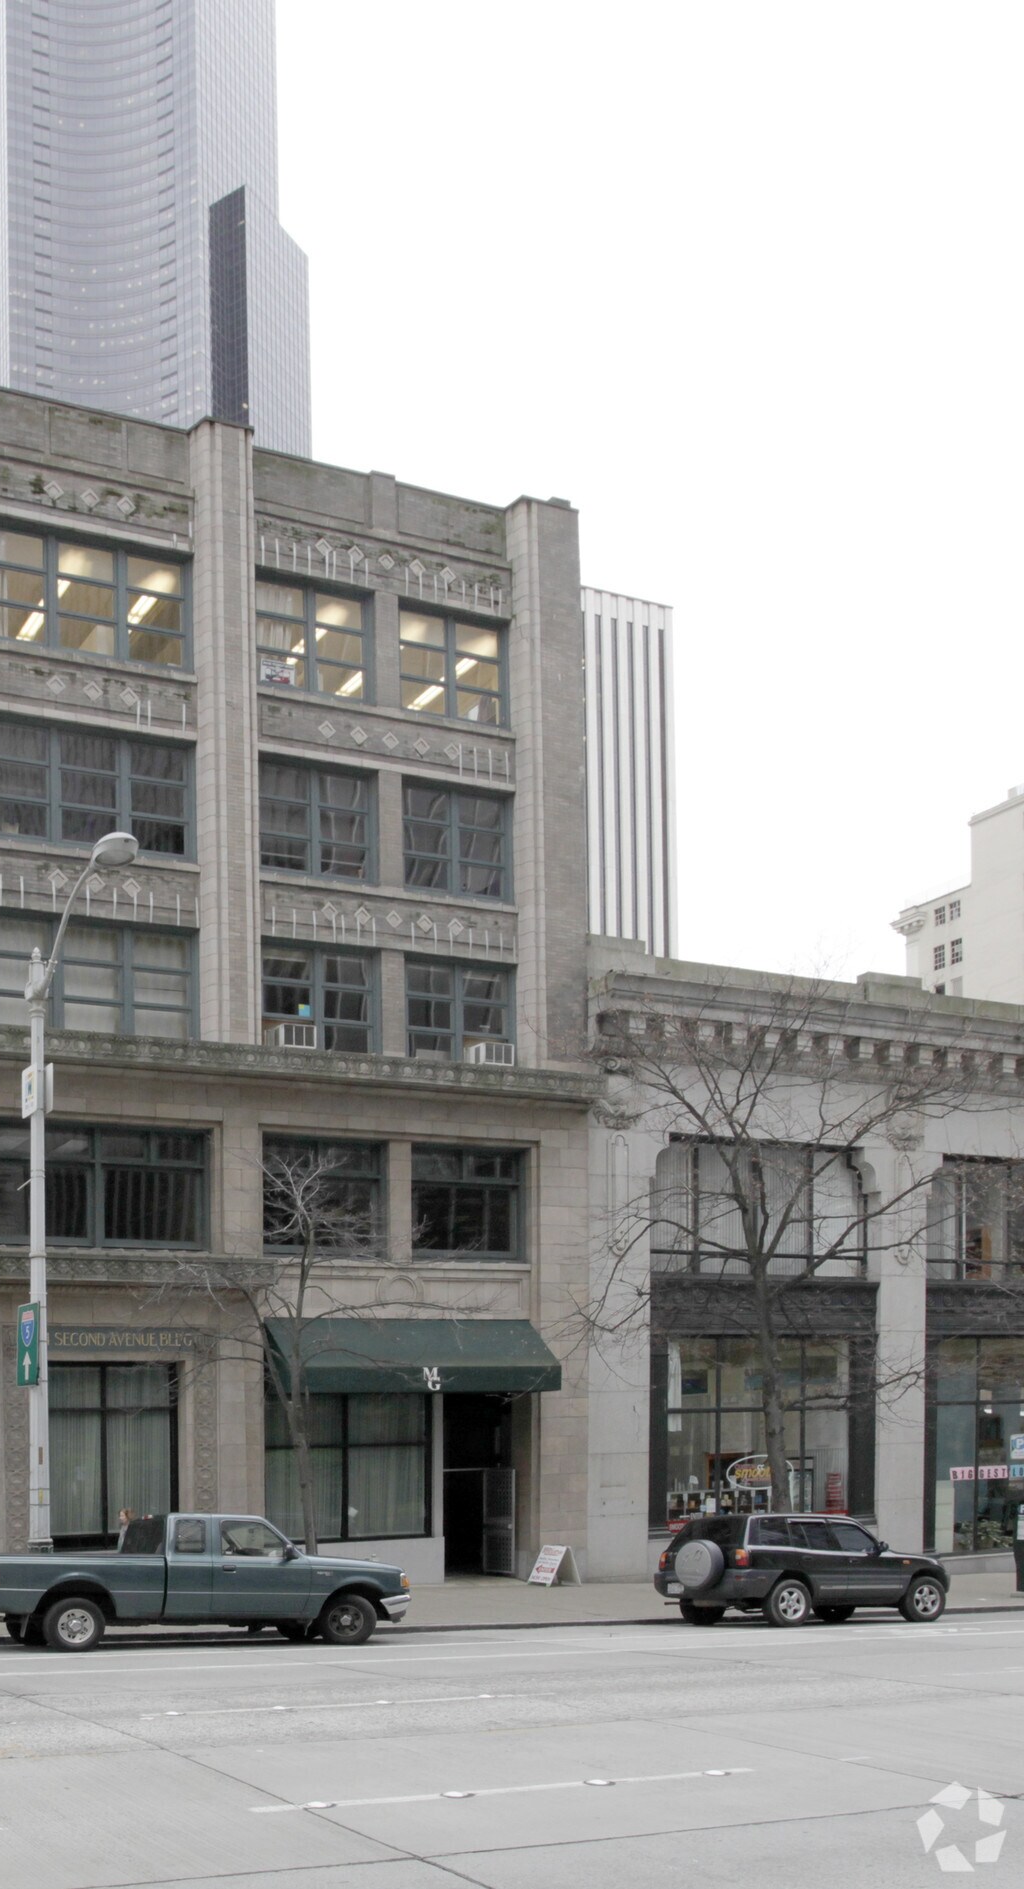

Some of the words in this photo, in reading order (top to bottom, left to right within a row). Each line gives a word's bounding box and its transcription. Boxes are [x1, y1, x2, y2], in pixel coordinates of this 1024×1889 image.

[25, 1325, 30, 1340] 5
[54, 1332, 106, 1346] SECOND
[108, 1332, 157, 1346] AVENUE
[952, 1467, 1006, 1480] BIGGEST
